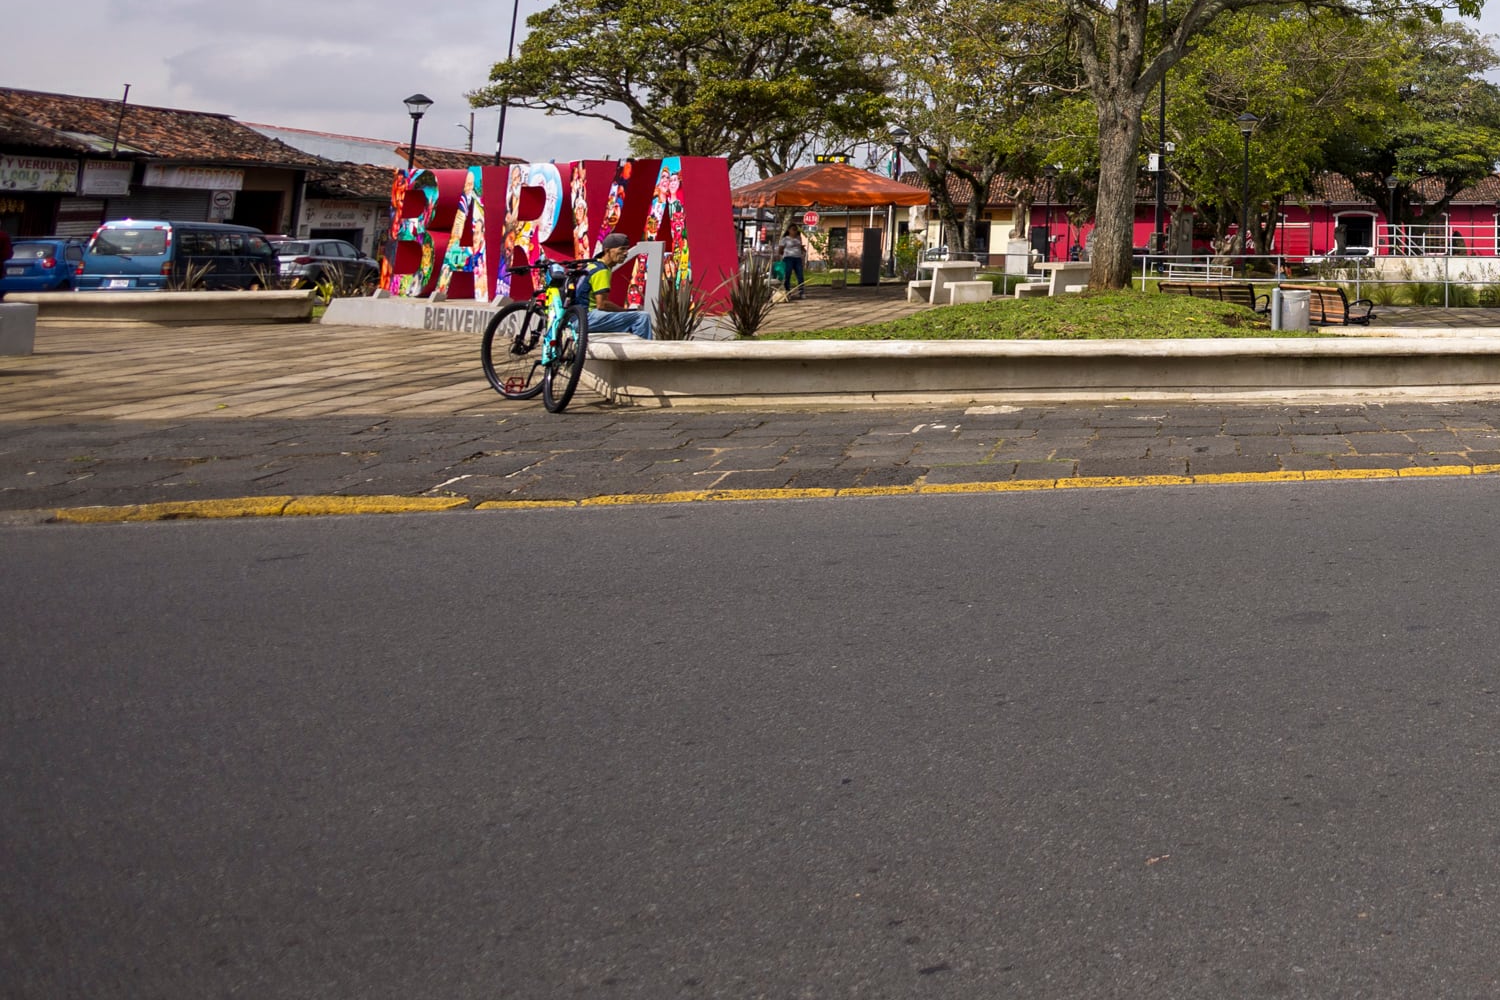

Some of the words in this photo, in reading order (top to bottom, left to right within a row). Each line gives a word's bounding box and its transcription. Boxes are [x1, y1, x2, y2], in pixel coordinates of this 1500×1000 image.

[6, 158, 15, 168] Y
[17, 159, 77, 171] VERDURAS
[177, 166, 243, 188] OFERTAZO
[377, 156, 735, 316] BARVA
